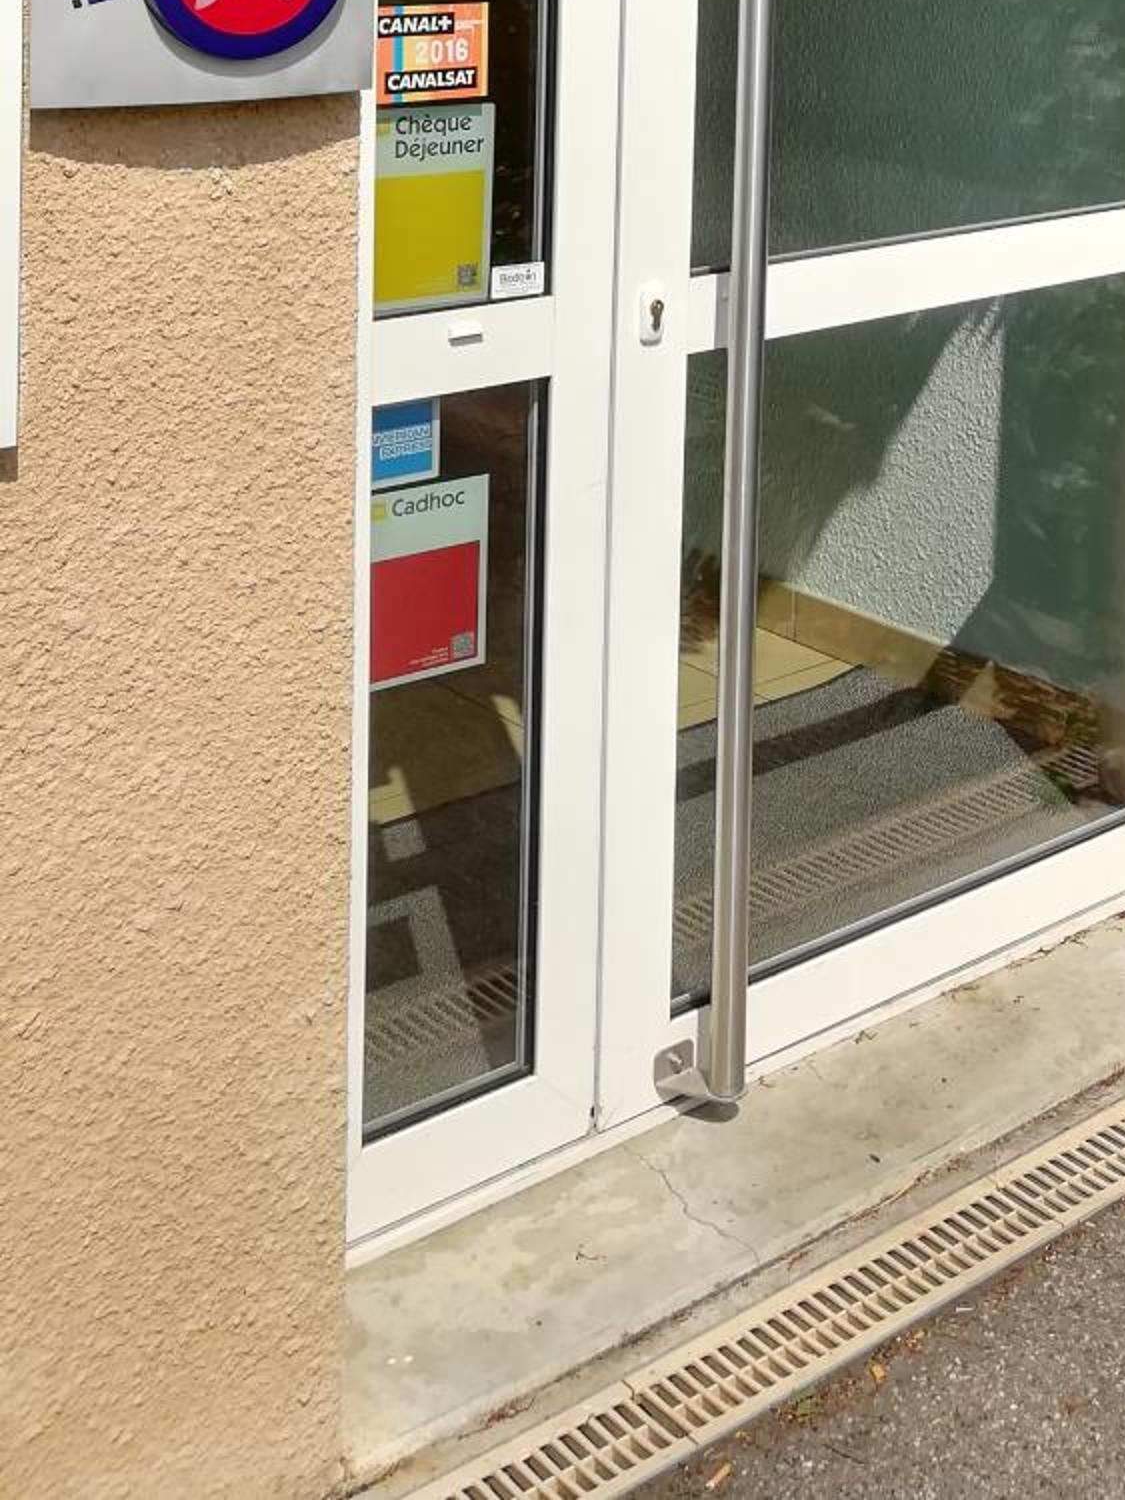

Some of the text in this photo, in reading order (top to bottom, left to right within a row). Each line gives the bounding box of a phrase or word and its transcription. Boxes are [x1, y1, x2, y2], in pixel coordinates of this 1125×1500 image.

[378, 16, 453, 35] CANAL+
[415, 39, 469, 64] 2016
[387, 70, 475, 92] CANALSAT
[396, 115, 472, 138] Chèque
[395, 137, 485, 161] Déjeuner
[392, 491, 465, 516] Cadhoc
